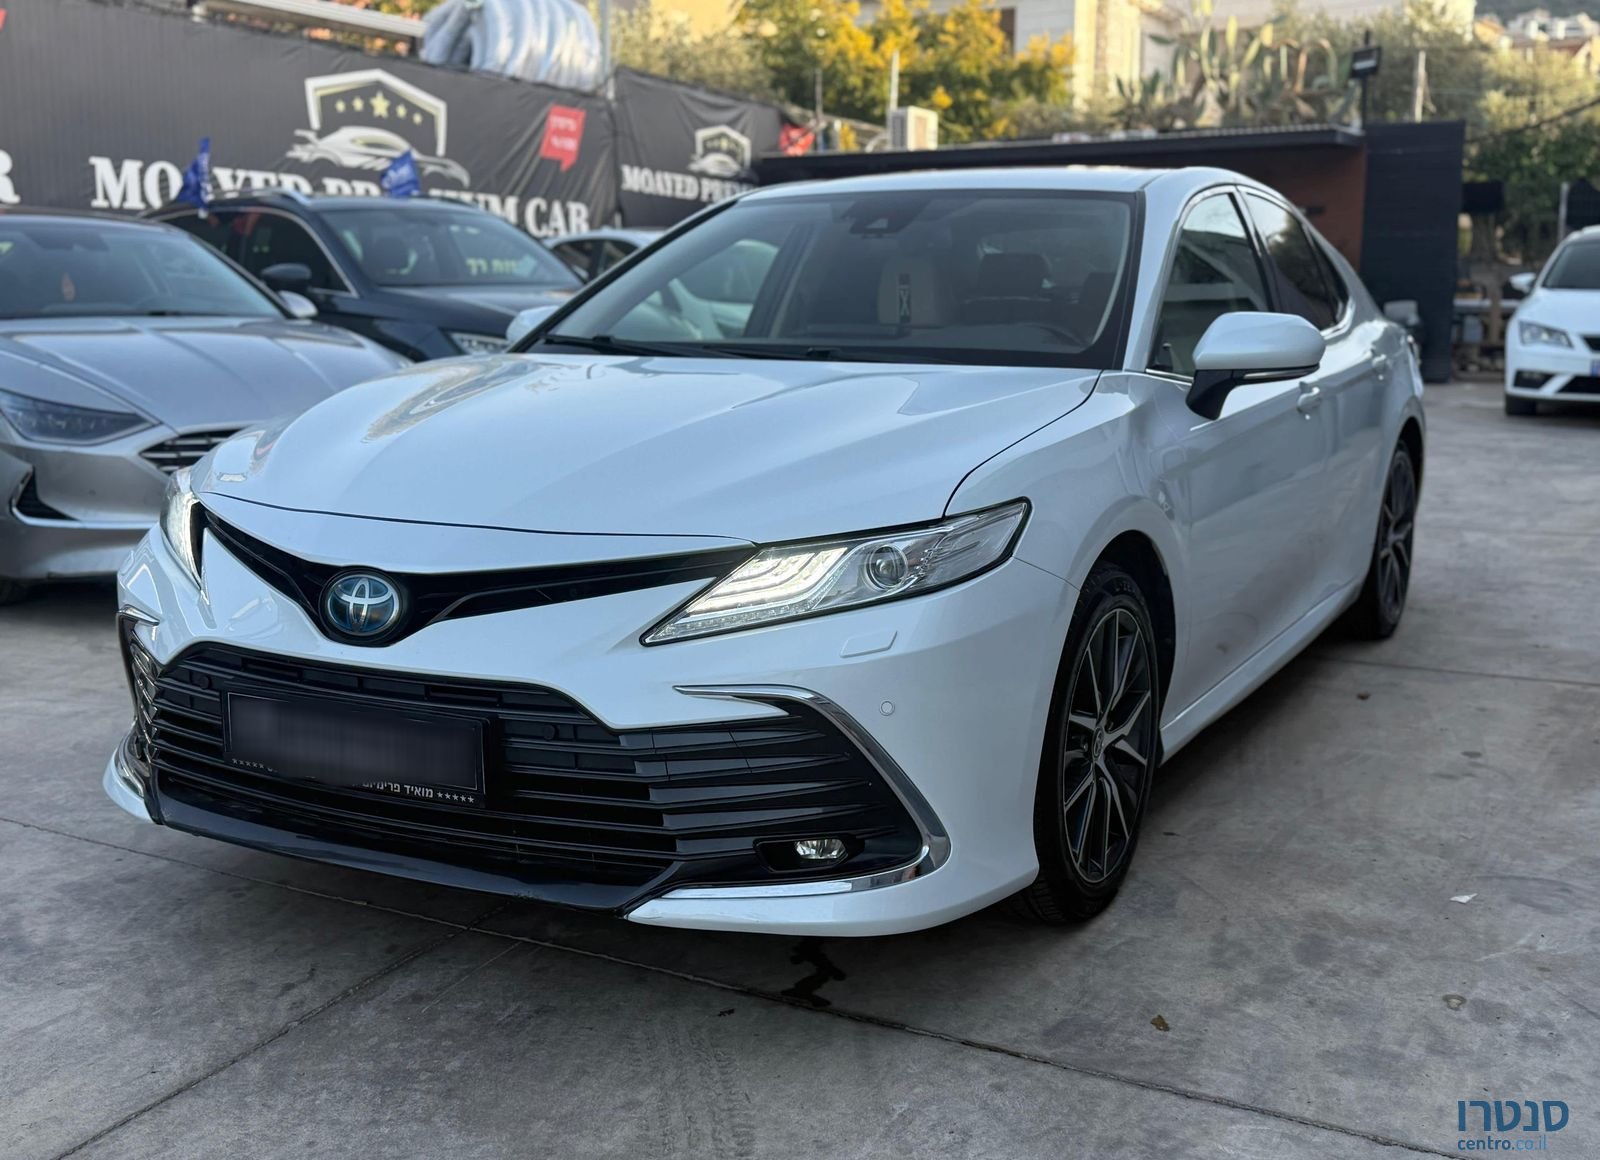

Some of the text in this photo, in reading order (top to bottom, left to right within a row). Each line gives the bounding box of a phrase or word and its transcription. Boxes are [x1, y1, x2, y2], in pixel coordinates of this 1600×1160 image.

[621, 164, 699, 201] MOAYED
[525, 196, 589, 239] CAR
[404, 784, 433, 798] מואיד
